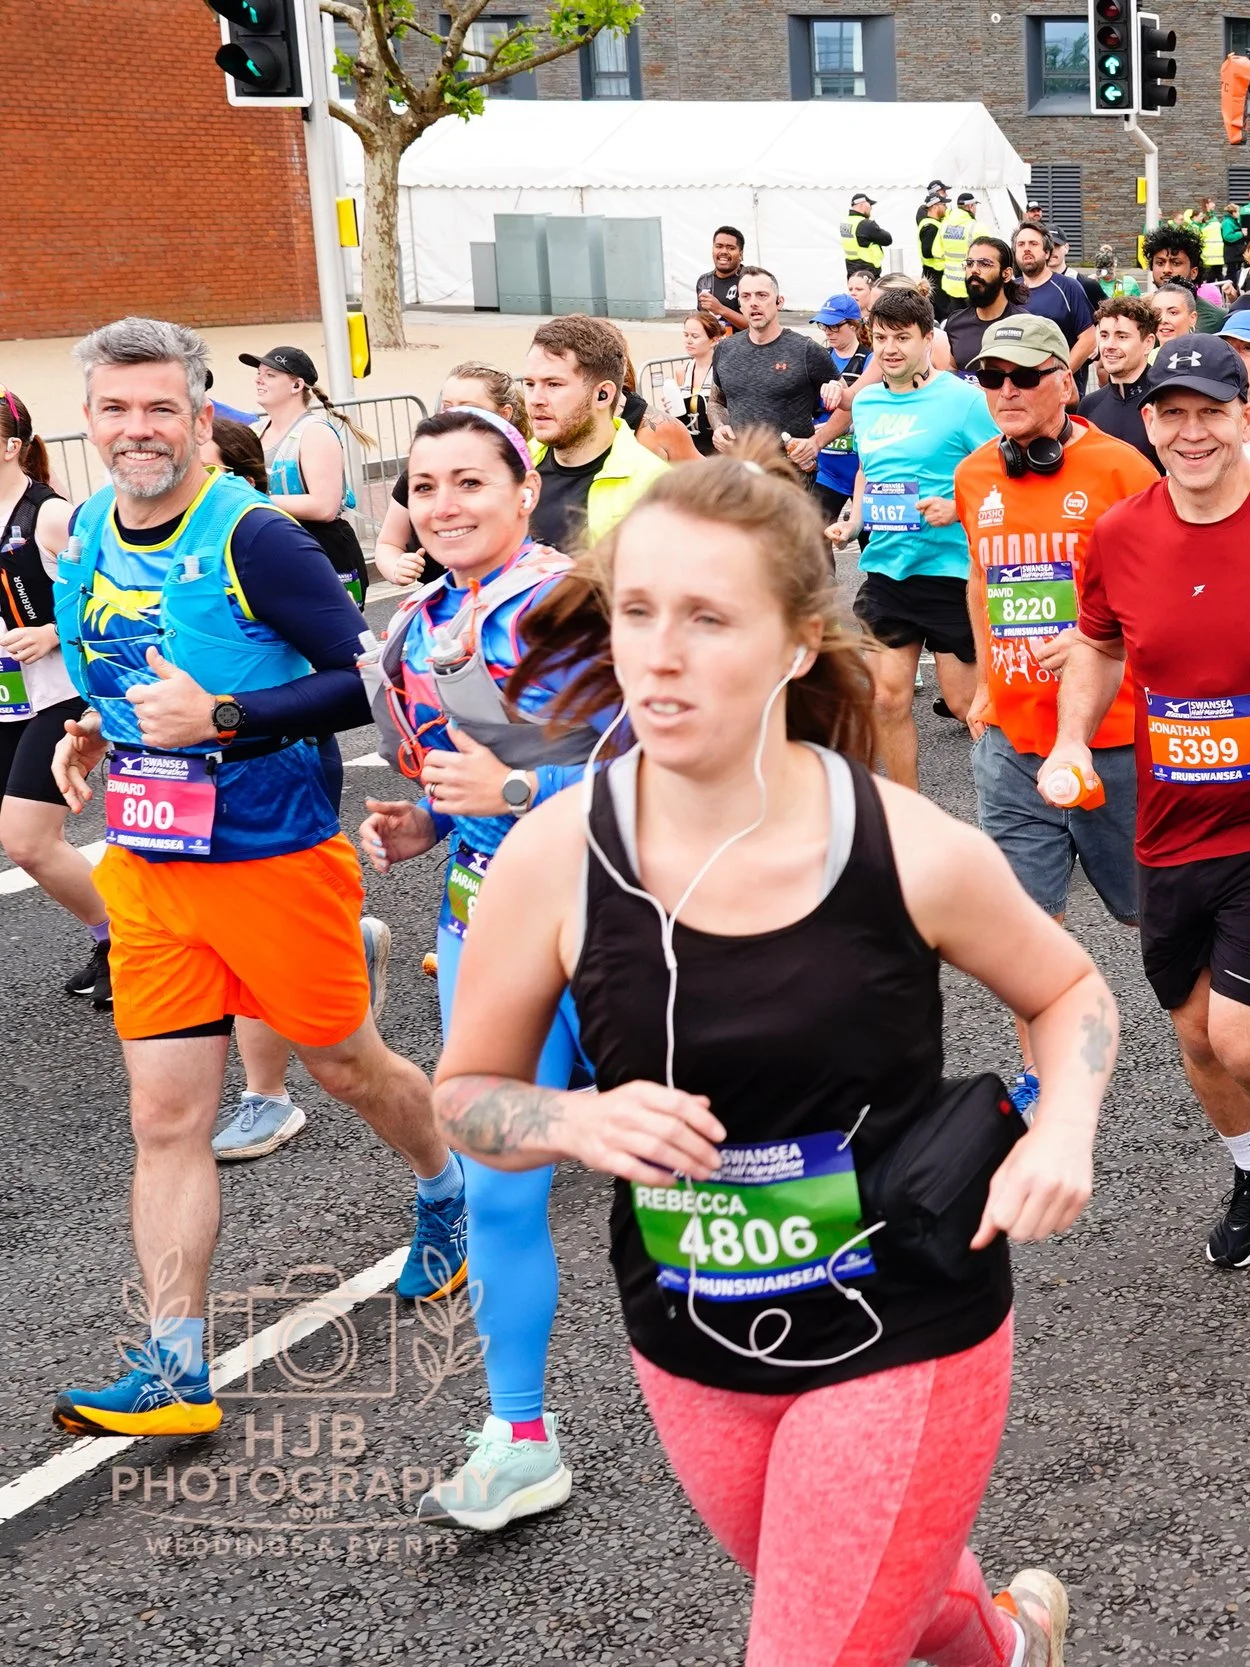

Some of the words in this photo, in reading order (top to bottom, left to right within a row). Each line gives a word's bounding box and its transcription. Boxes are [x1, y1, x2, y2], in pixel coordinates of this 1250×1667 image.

[871, 504, 906, 521] 8167
[978, 508, 1004, 520] OYSHO
[1022, 564, 1054, 573] SWANSEA
[13, 575, 38, 621] KARRIMOR
[987, 588, 1013, 599] DAVID
[1002, 596, 1057, 622] 8220
[1190, 699, 1234, 710] SWANSEA
[1149, 721, 1211, 737] JONATHAN
[1168, 737, 1239, 765] 5399
[143, 757, 189, 770] SWANSEA
[1170, 770, 1243, 782] #RUNSWANSEA
[107, 779, 146, 796] EDWARD
[122, 797, 175, 830] 800
[450, 868, 480, 895] SARAH
[721, 1143, 803, 1166] SWANSEA
[635, 1186, 748, 1217] REBECCA
[678, 1215, 818, 1266] 4806
